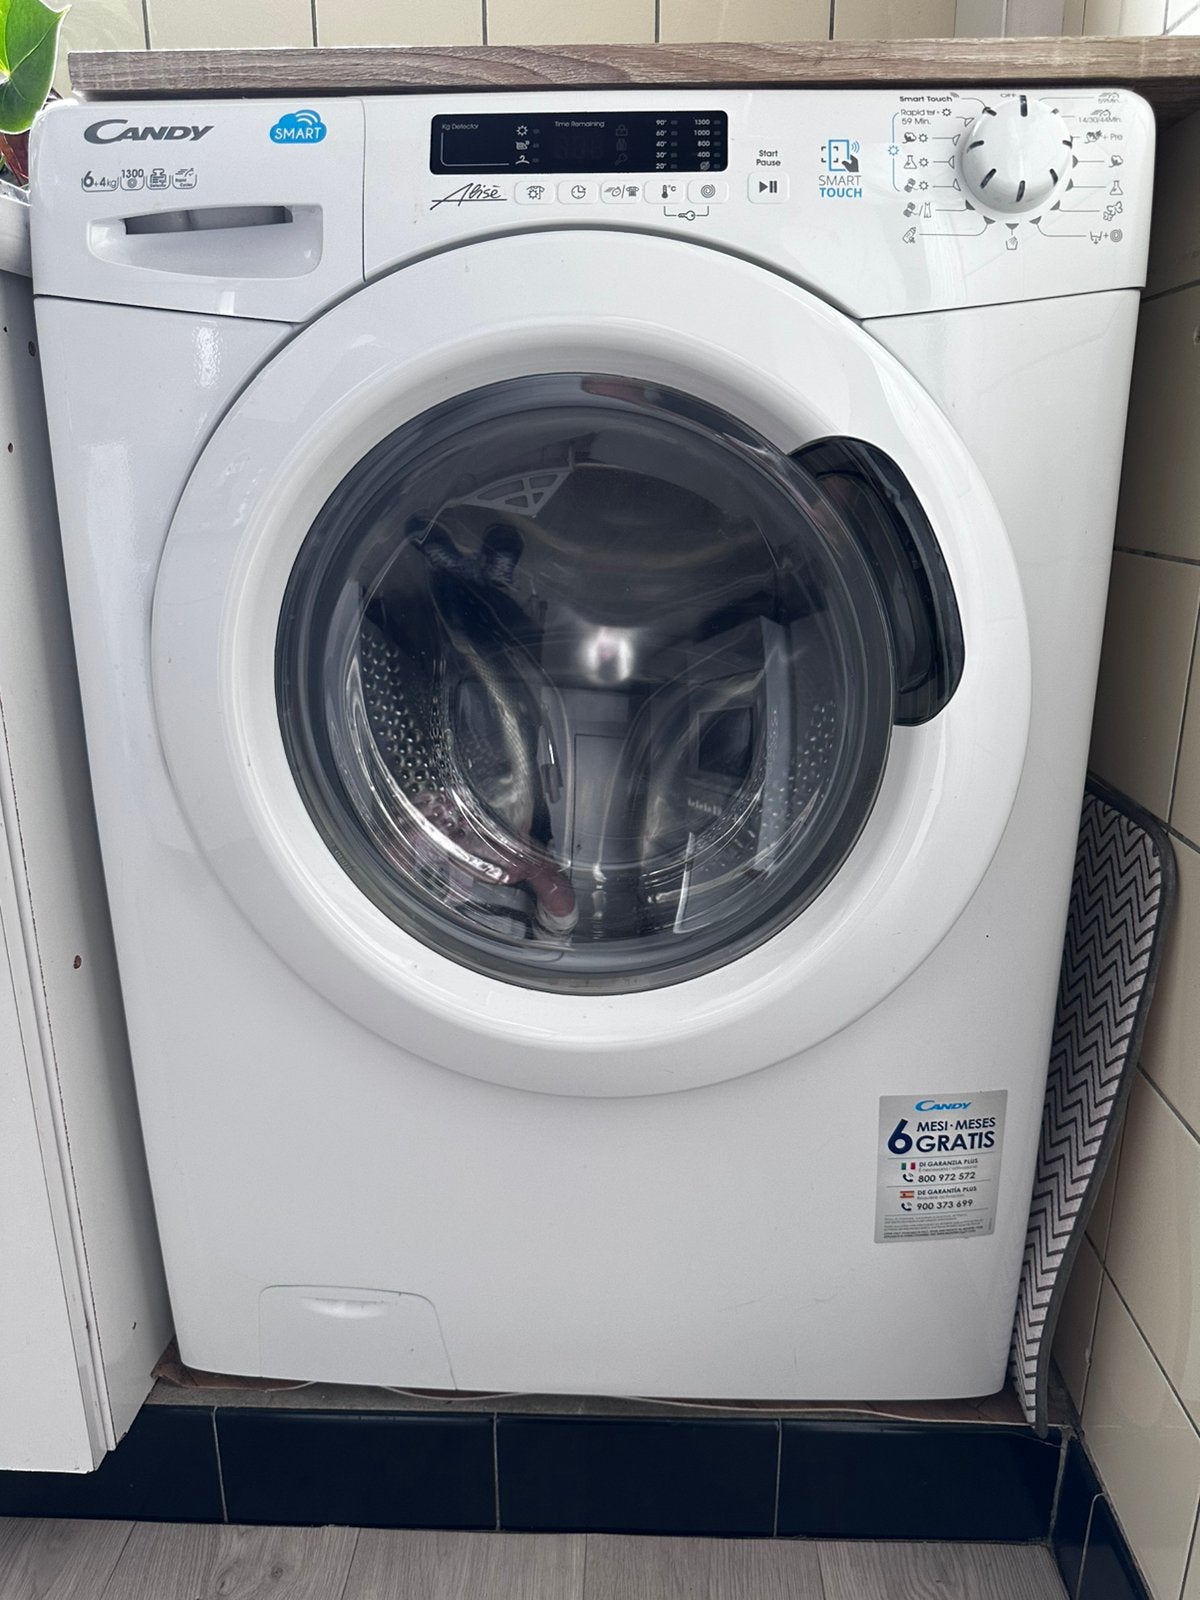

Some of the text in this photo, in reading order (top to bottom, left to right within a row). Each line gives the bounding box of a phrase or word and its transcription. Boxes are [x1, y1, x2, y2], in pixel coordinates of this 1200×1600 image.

[571, 120, 605, 128] Remaining
[83, 119, 215, 145] CANDY
[274, 127, 321, 140] SMART
[759, 149, 778, 157] Start
[121, 169, 144, 178] 1300
[818, 175, 861, 186] SMART
[819, 188, 862, 198] TOUCH
[915, 1100, 972, 1112] CANDY
[888, 1118, 913, 1154] 6
[916, 1131, 995, 1152] GRATIS
[918, 1171, 976, 1183] 800 972 572
[927, 1186, 961, 1195] GARANTÍA
[916, 1199, 973, 1210] 900 373 699
